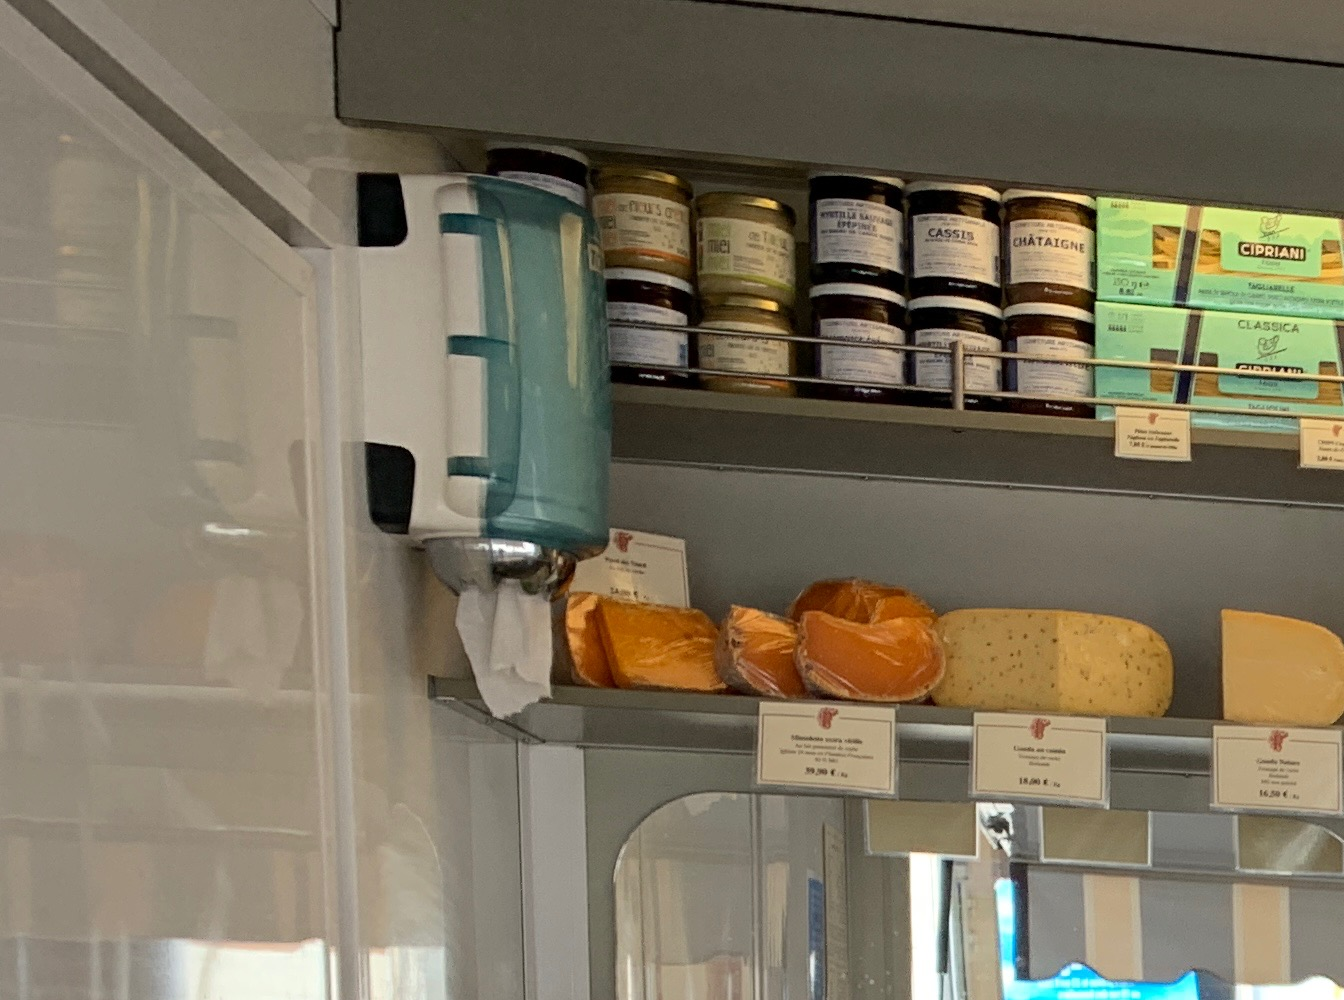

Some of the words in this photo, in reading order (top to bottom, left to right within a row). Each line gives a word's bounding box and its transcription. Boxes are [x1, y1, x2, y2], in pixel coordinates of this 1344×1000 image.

[928, 228, 975, 241] CASSIS
[1240, 244, 1304, 260] CIPRIANI
[1238, 319, 1300, 334] CLASSICA
